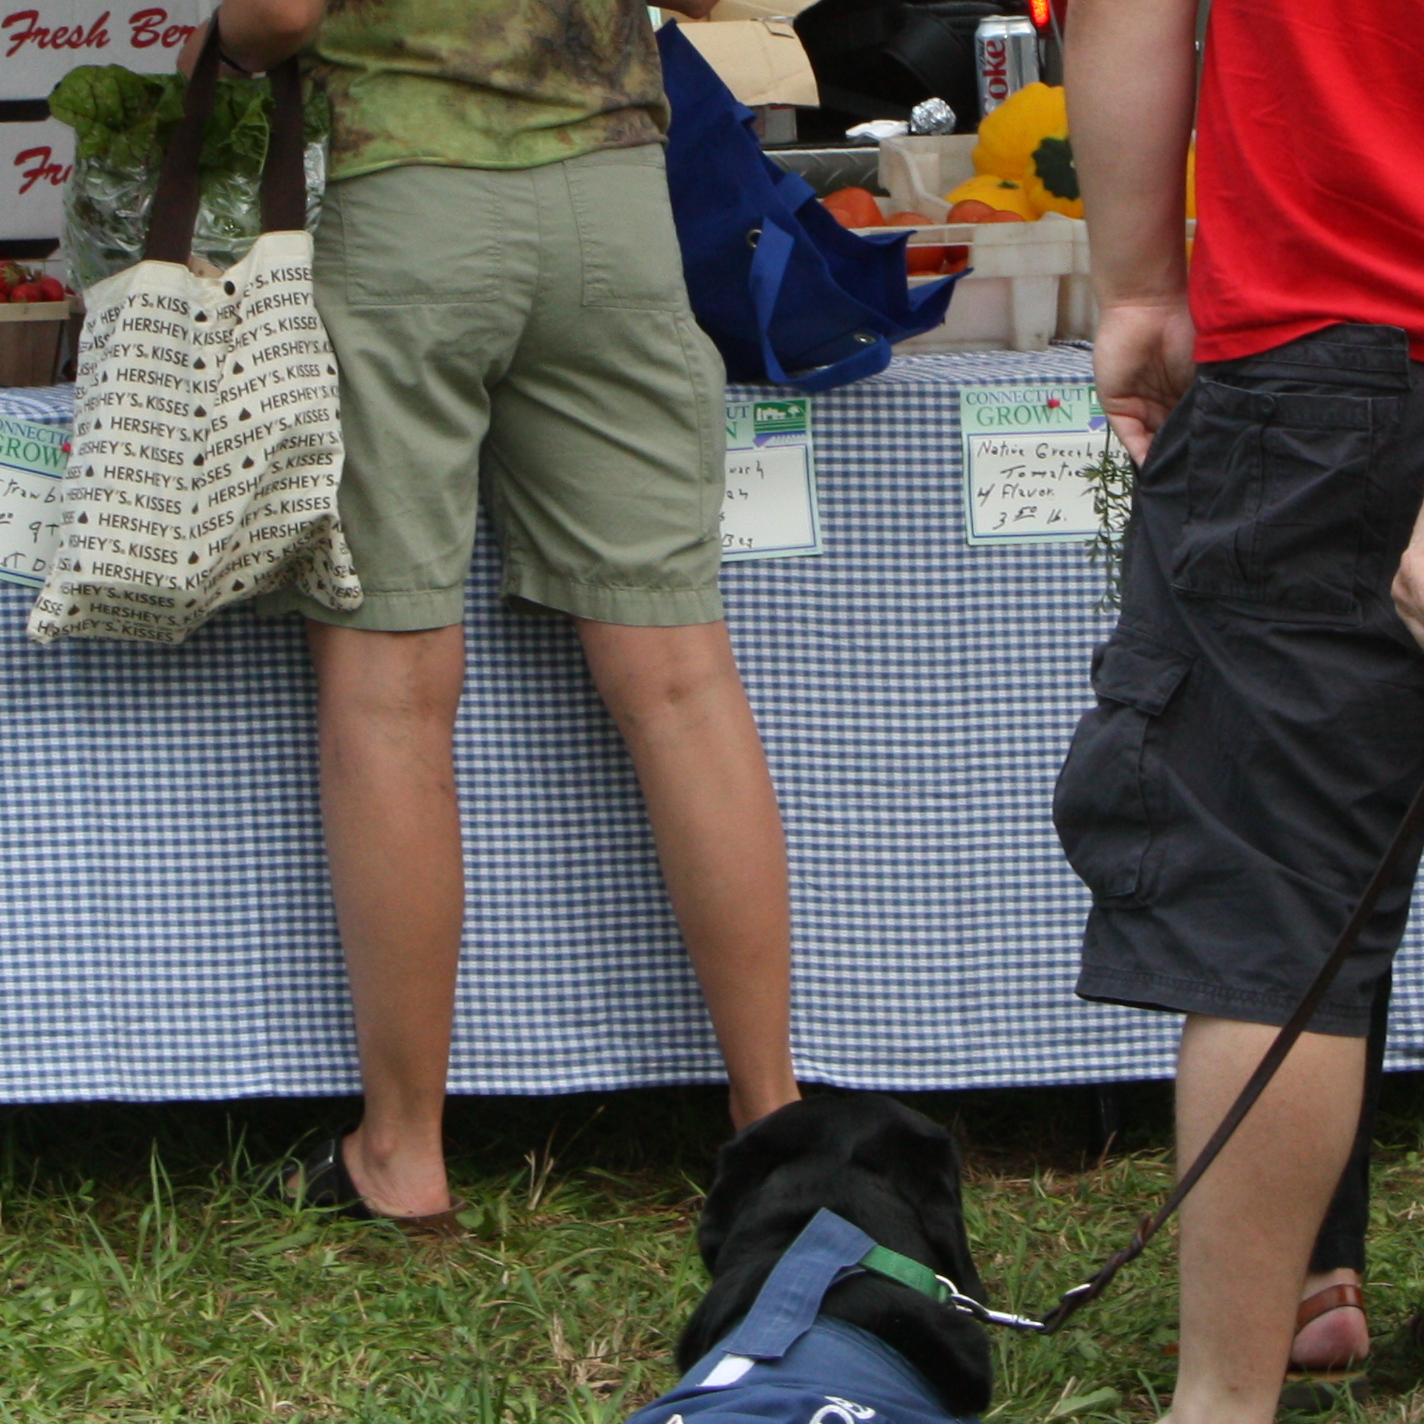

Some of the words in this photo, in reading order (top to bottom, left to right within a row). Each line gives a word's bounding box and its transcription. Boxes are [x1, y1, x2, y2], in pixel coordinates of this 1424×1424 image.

[1, 9, 111, 58] Fresh
[982, 40, 1008, 115] oke
[152, 346, 189, 367] KISSE
[966, 388, 1086, 406] CONNECTICUT
[977, 403, 1074, 427] GROWN
